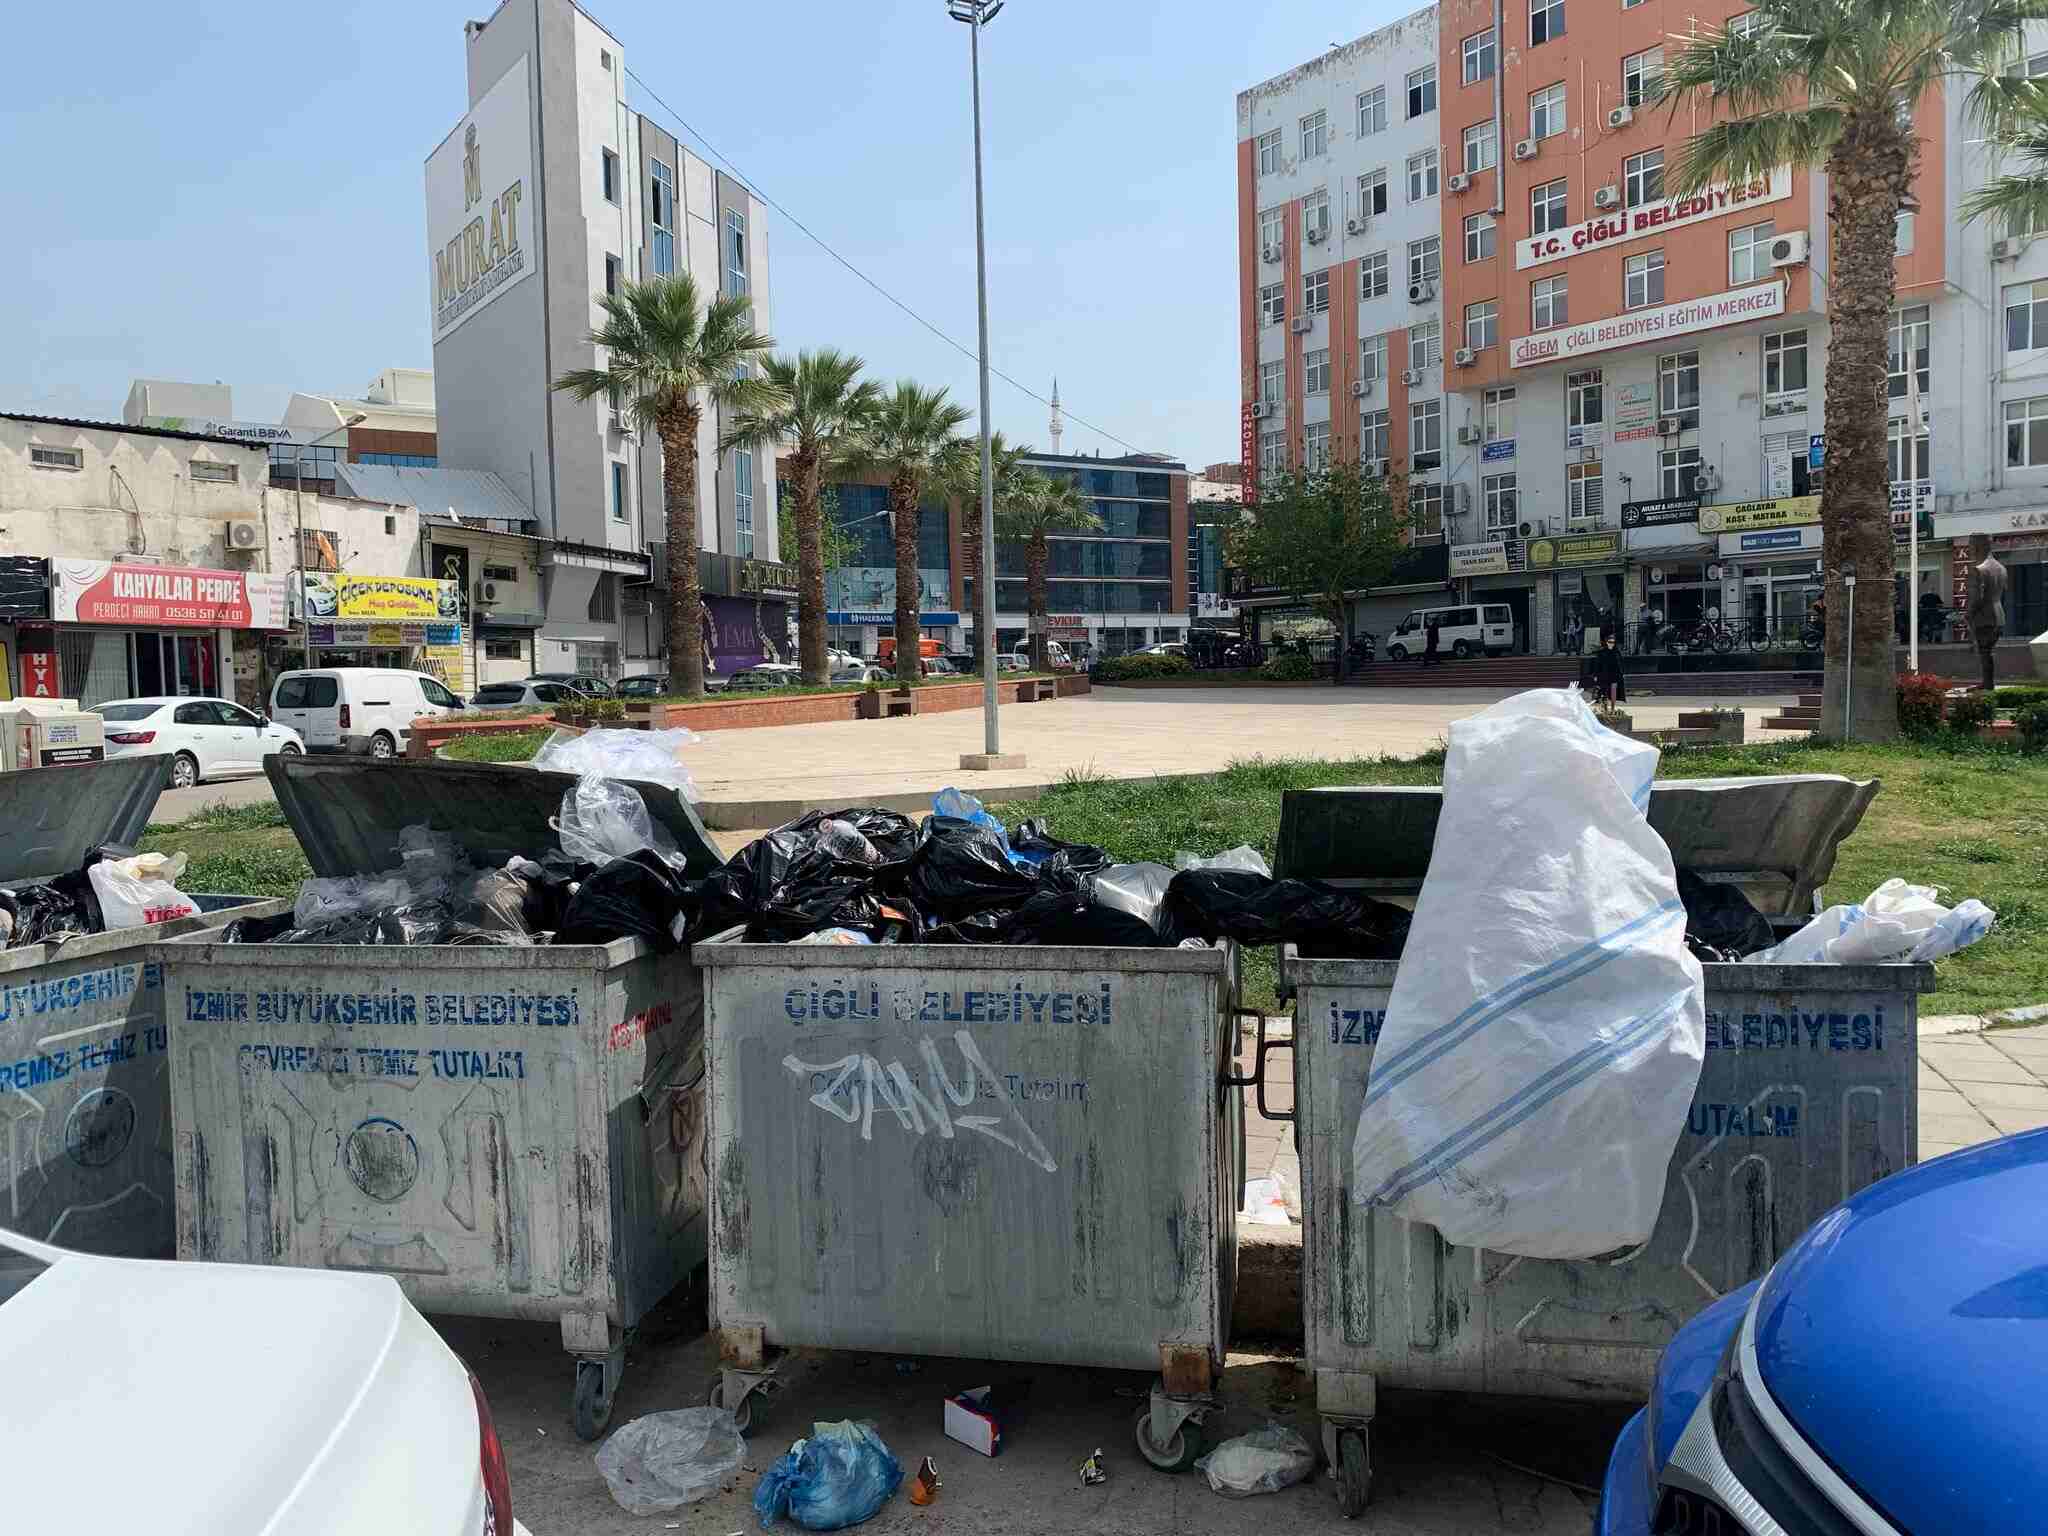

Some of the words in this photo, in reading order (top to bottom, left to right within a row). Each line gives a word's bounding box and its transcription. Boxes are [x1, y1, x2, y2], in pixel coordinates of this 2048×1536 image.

[435, 178, 523, 312] MURAT
[1530, 238, 1566, 258] T.C.
[1572, 211, 1628, 249] ÇİĞLİ
[1566, 328, 1595, 352] ÇİĞLİ
[1598, 314, 1665, 342] BELEDİYESİ
[1668, 304, 1713, 328] EĞİTİM
[1717, 288, 1777, 317] MERKEZİ
[218, 425, 256, 438] Garanti
[258, 428, 292, 439] BBVA
[113, 571, 192, 601] KAHYALAR
[197, 576, 241, 604] PERDE
[340, 577, 374, 607] ÇİÇEK
[166, 607, 197, 620] 0536
[185, 985, 249, 1023] İZMİR
[256, 985, 417, 1031] BÜYÜKŞEHİR
[425, 987, 581, 1026] BELEDİYESİ
[784, 979, 881, 1026] ÇİĞLİ
[1704, 1006, 1884, 1050] ELEDİYESİ
[1690, 1102, 1798, 1137] UTALIM
